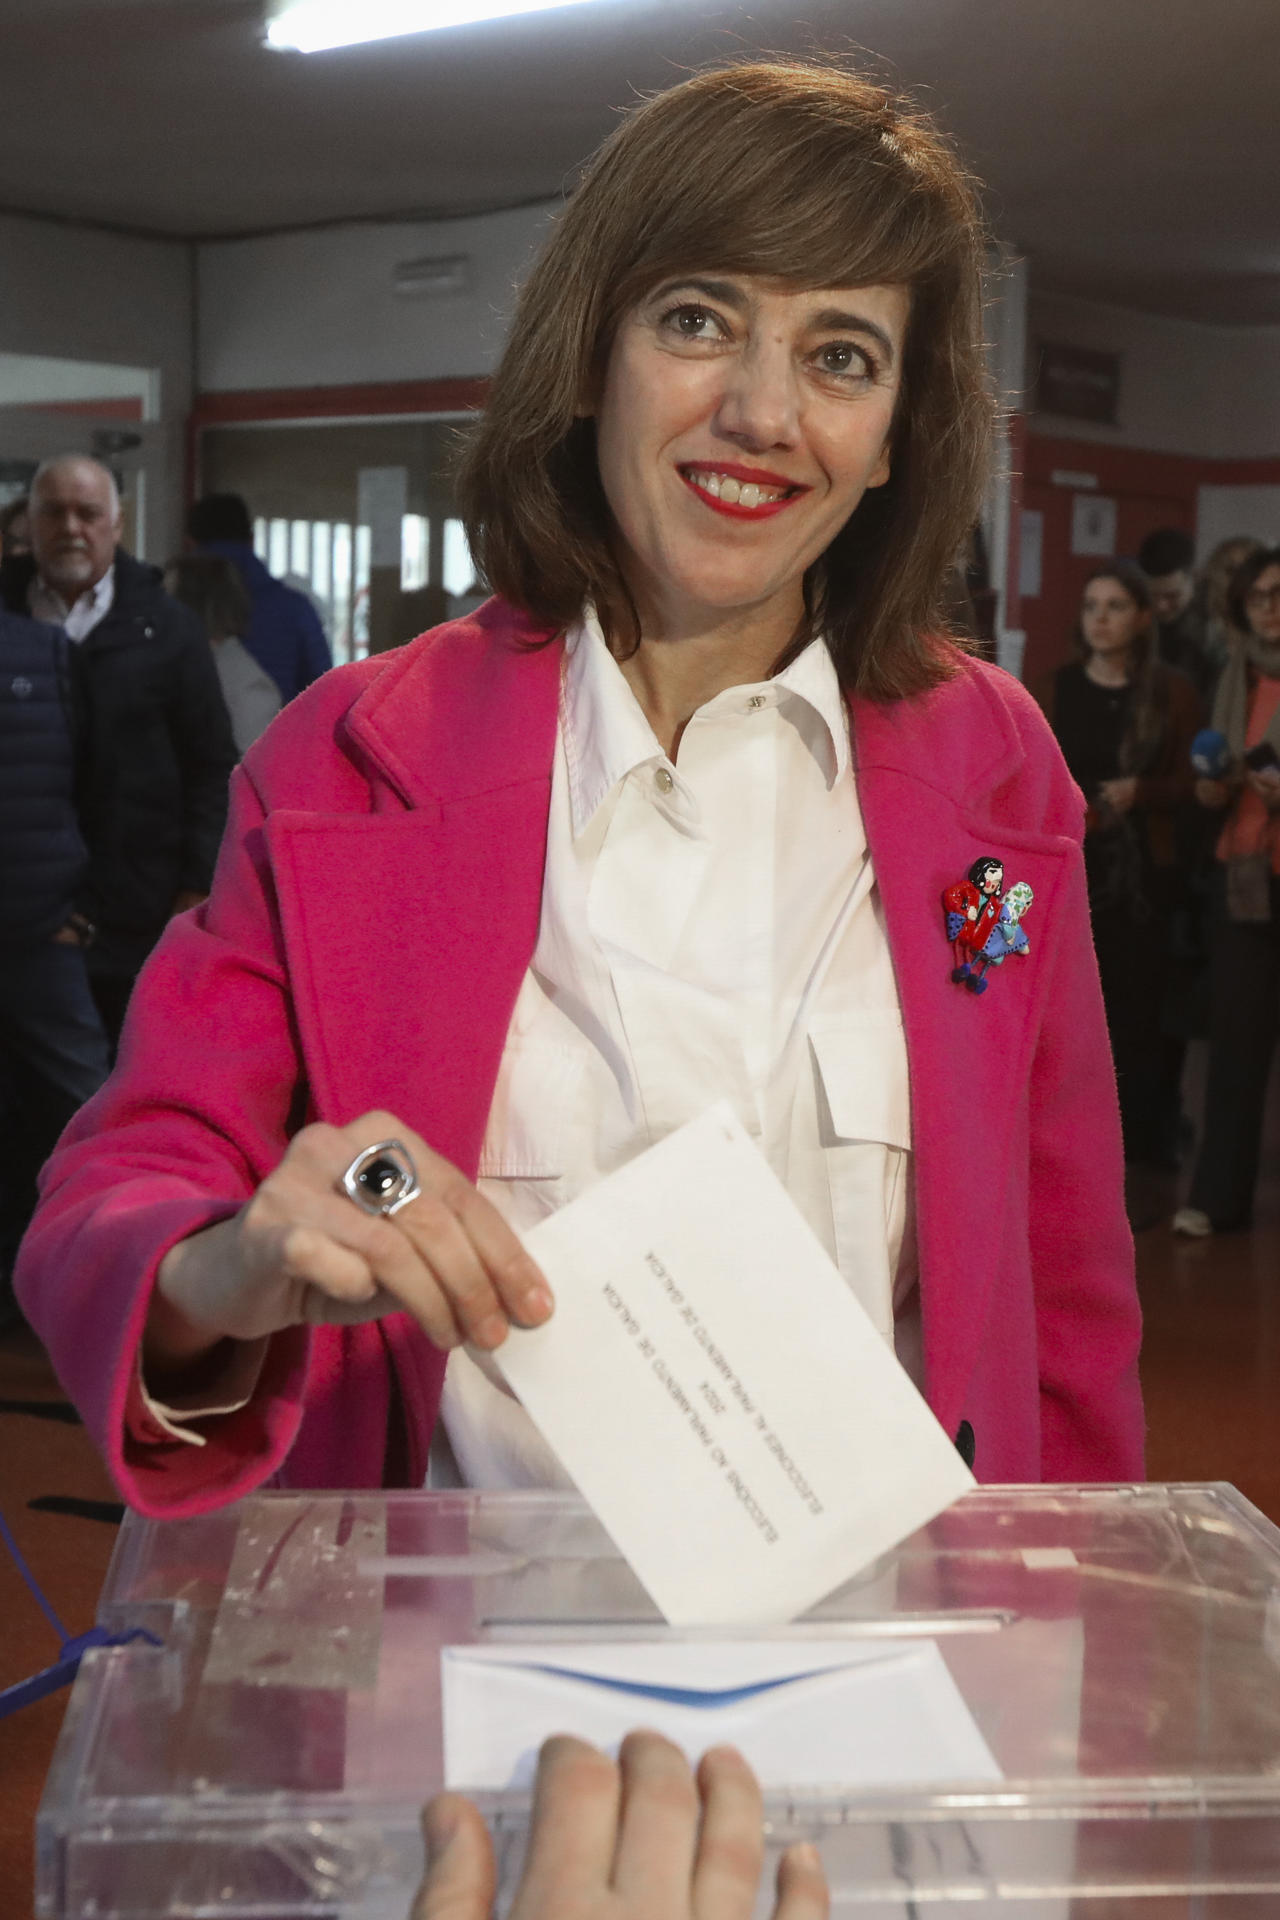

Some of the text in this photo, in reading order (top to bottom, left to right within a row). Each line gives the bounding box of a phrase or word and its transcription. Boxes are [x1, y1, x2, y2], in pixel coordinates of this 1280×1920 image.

[601, 1282, 780, 1545] ELECCIONS AO PARLAMENTO DE GALICIA
[644, 1250, 825, 1516] ELECCIONES AL PARLAMENTO DE GALICIA
